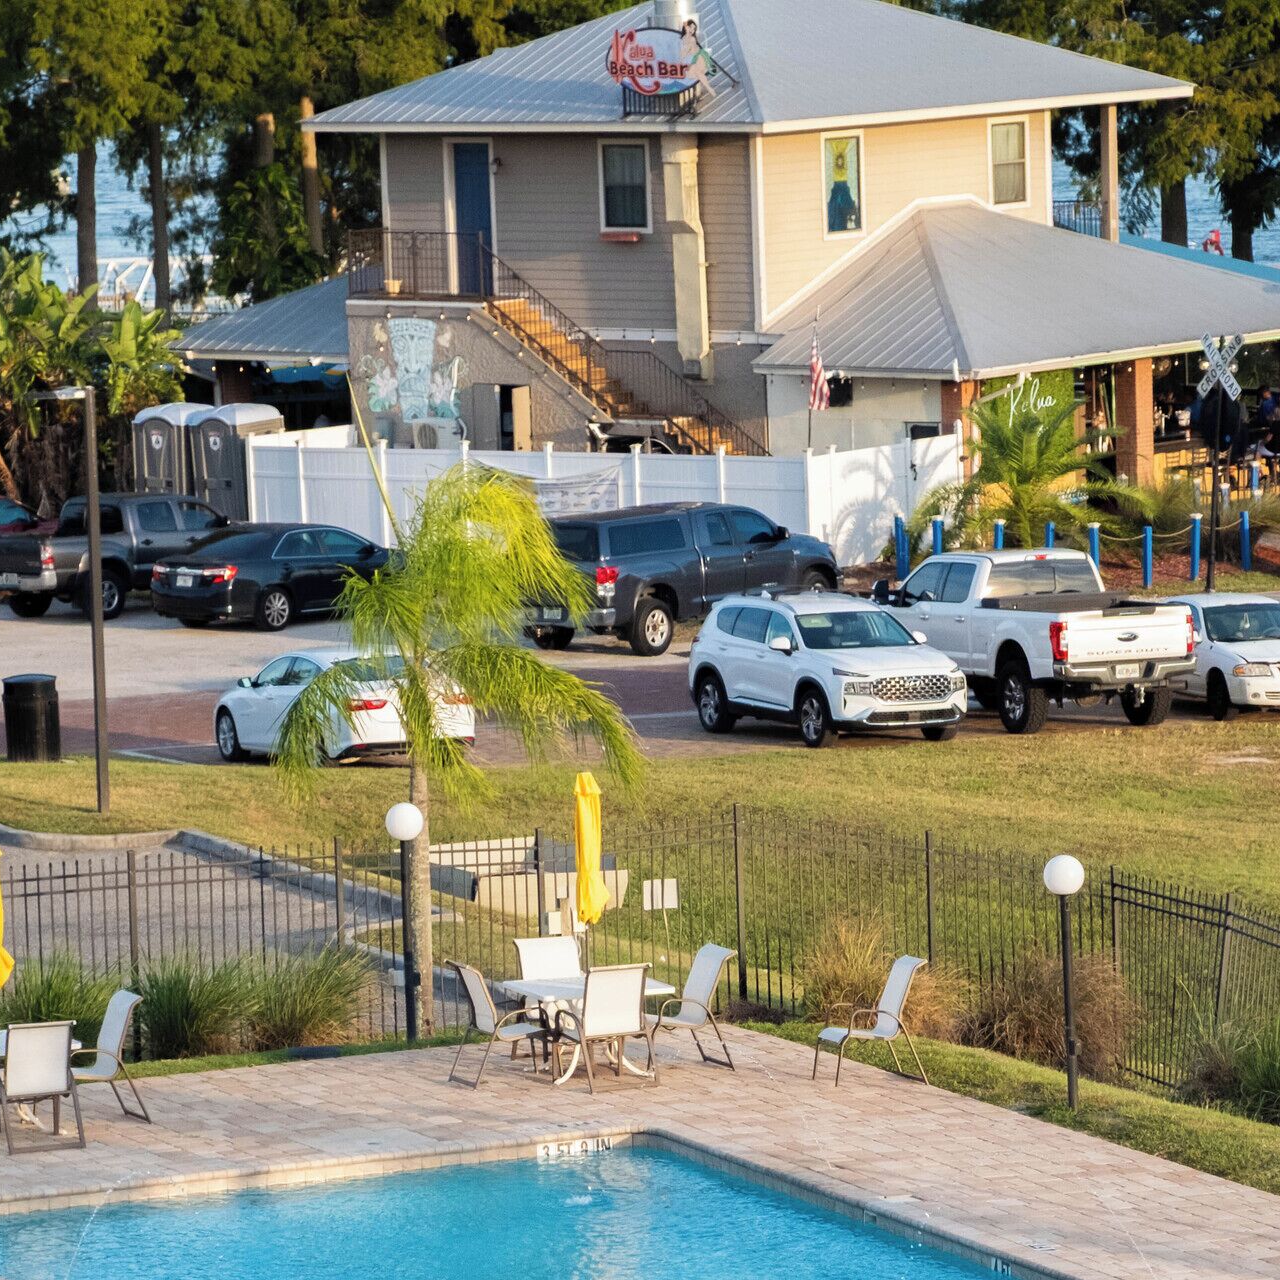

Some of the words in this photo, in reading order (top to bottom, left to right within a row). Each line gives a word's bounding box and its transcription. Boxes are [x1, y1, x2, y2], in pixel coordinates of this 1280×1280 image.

[610, 61, 654, 76] Beach
[658, 61, 688, 77] Bar
[1200, 335, 1242, 392] CROSSING
[596, 1138, 611, 1151] IN
